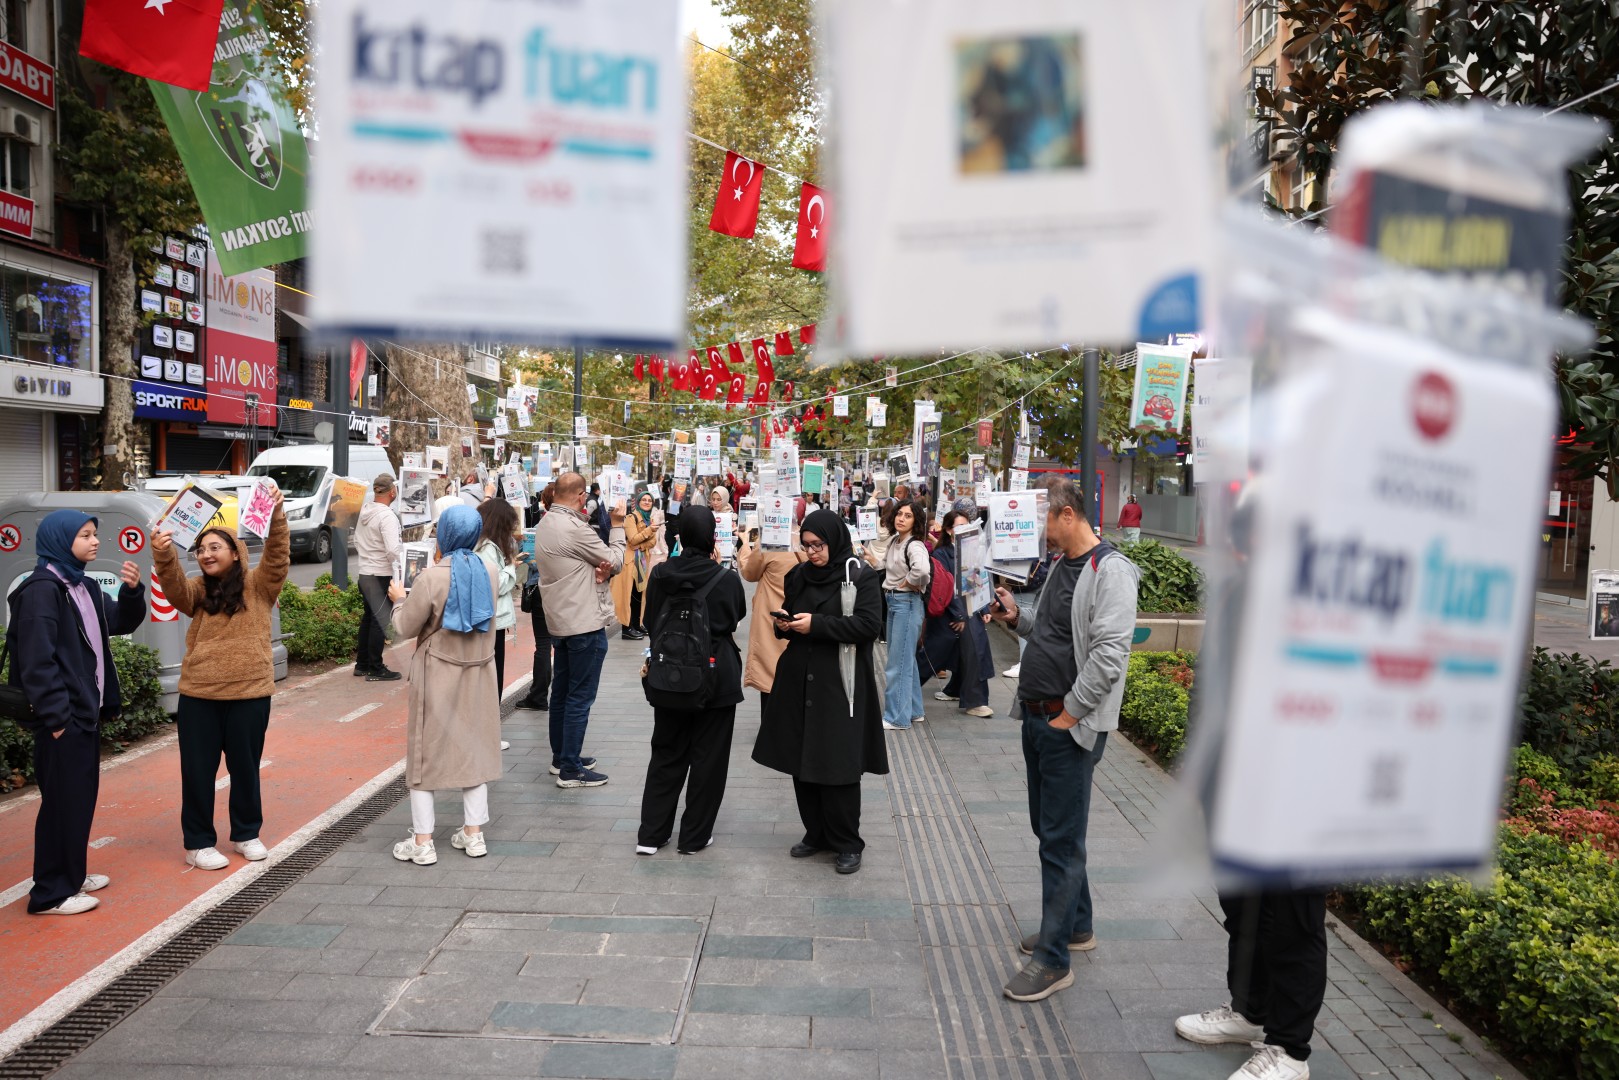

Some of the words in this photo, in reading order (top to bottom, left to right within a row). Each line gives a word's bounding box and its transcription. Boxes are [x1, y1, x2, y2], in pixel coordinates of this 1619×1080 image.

[0, 202, 30, 226] MM
[349, 411, 368, 434] Ümit
[994, 520, 1015, 533] kitap
[1015, 519, 1035, 530] fuarı
[95, 576, 116, 585] İYESİ
